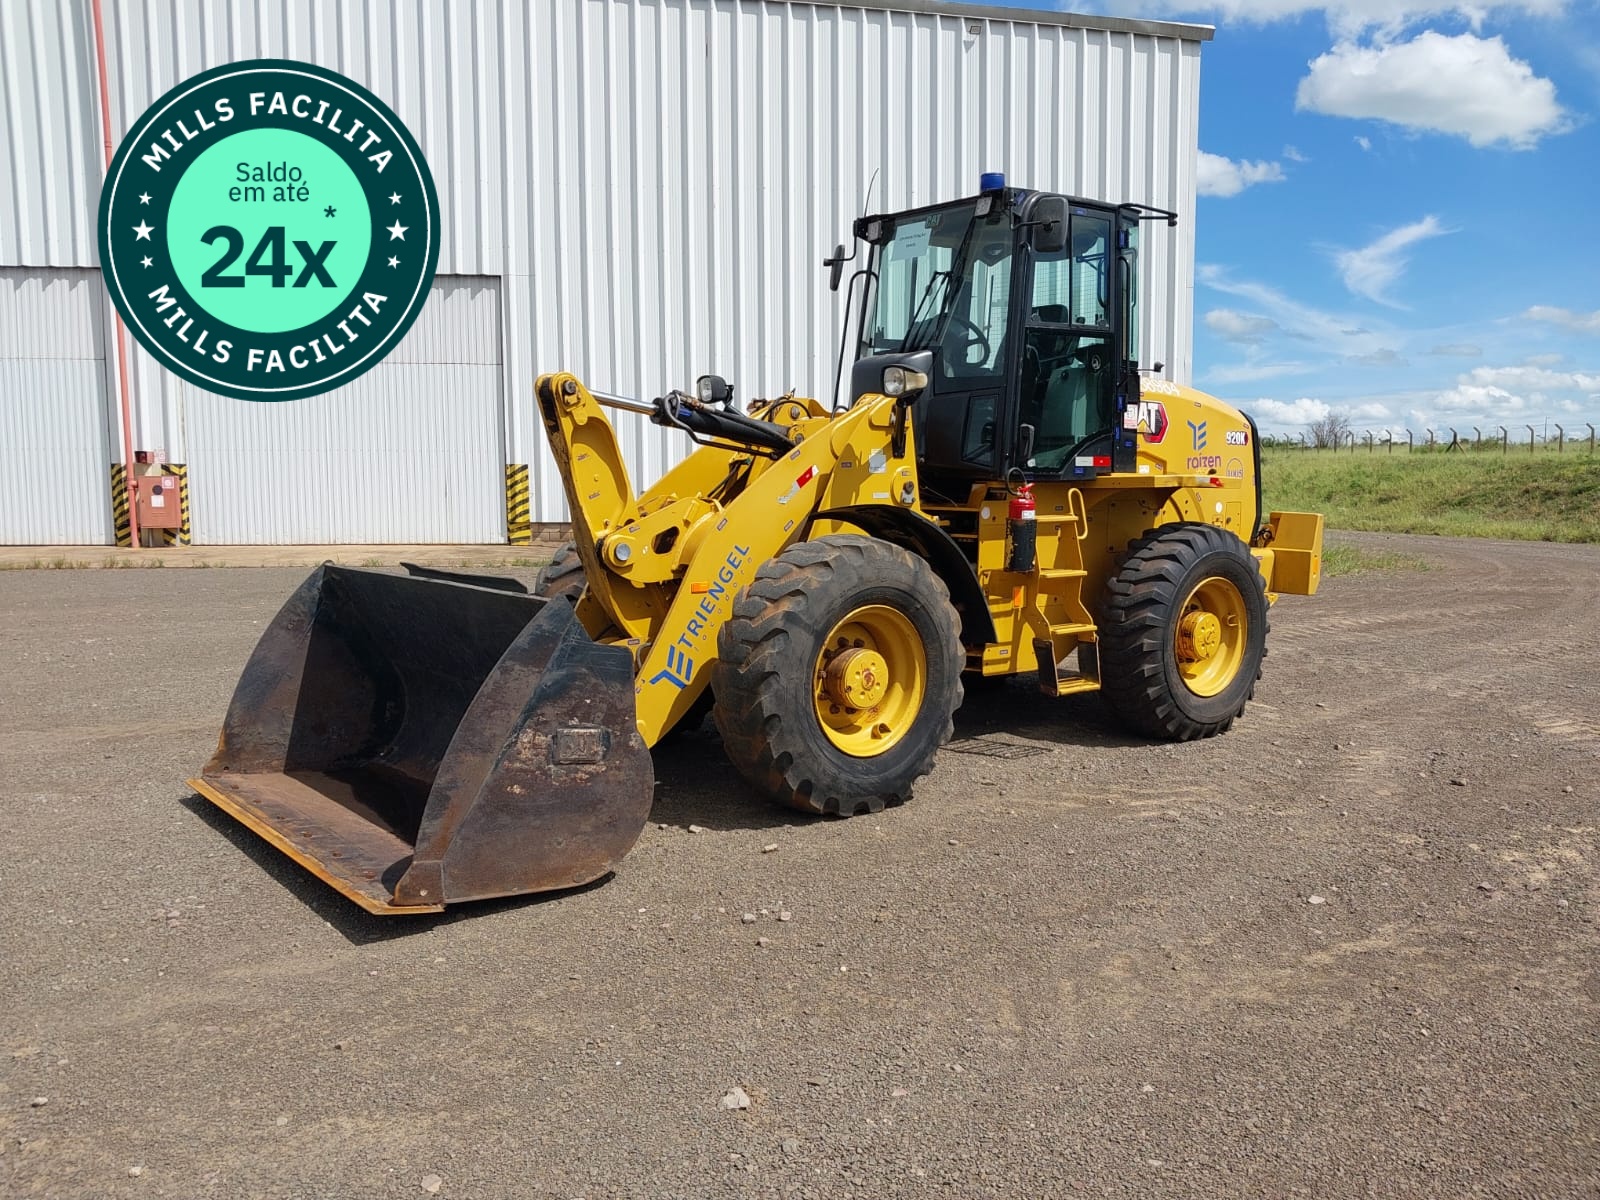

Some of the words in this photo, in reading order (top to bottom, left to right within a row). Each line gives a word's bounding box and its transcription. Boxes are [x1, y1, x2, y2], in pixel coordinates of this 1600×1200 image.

[1137, 402, 1159, 434] AT
[1226, 431, 1246, 446] 920K
[677, 545, 750, 648] TRIENGEL
